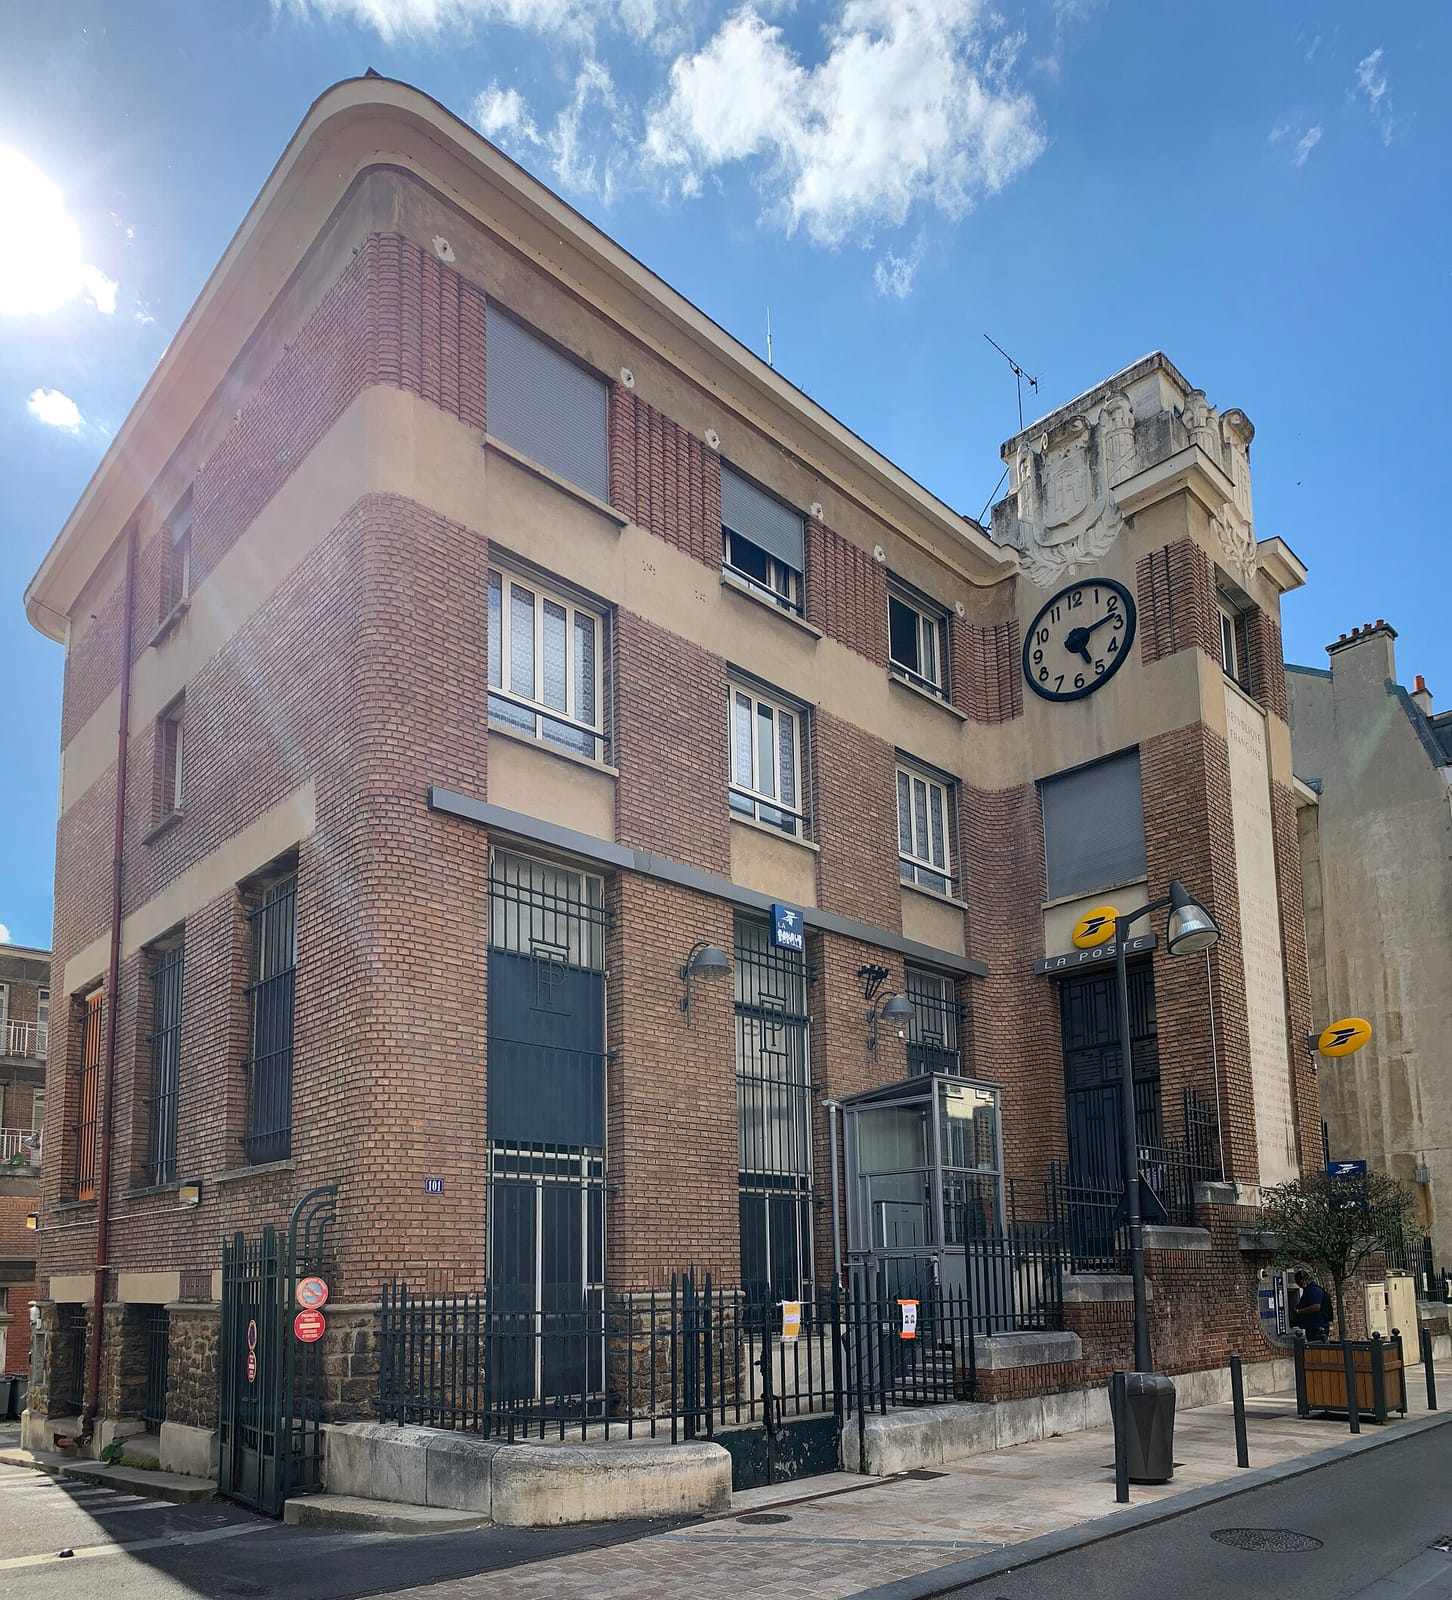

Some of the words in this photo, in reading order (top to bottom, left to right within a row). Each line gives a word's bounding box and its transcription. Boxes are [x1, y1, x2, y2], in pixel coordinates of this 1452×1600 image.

[1067, 591, 1082, 610] 12
[1094, 589, 1099, 604] 1
[1107, 596, 1118, 612] 2
[1050, 606, 1060, 624] 11
[1113, 614, 1123, 630] 3
[1036, 628, 1049, 646] 10
[1107, 636, 1118, 653] 4
[1033, 649, 1043, 664] 9
[1039, 667, 1049, 681] 8
[1095, 659, 1105, 675] 5
[1054, 675, 1064, 692] 7
[1074, 673, 1085, 688] 6
[1044, 957, 1066, 970] LA
[1080, 939, 1143, 961] POSTE
[429, 1180, 441, 1191] 101
